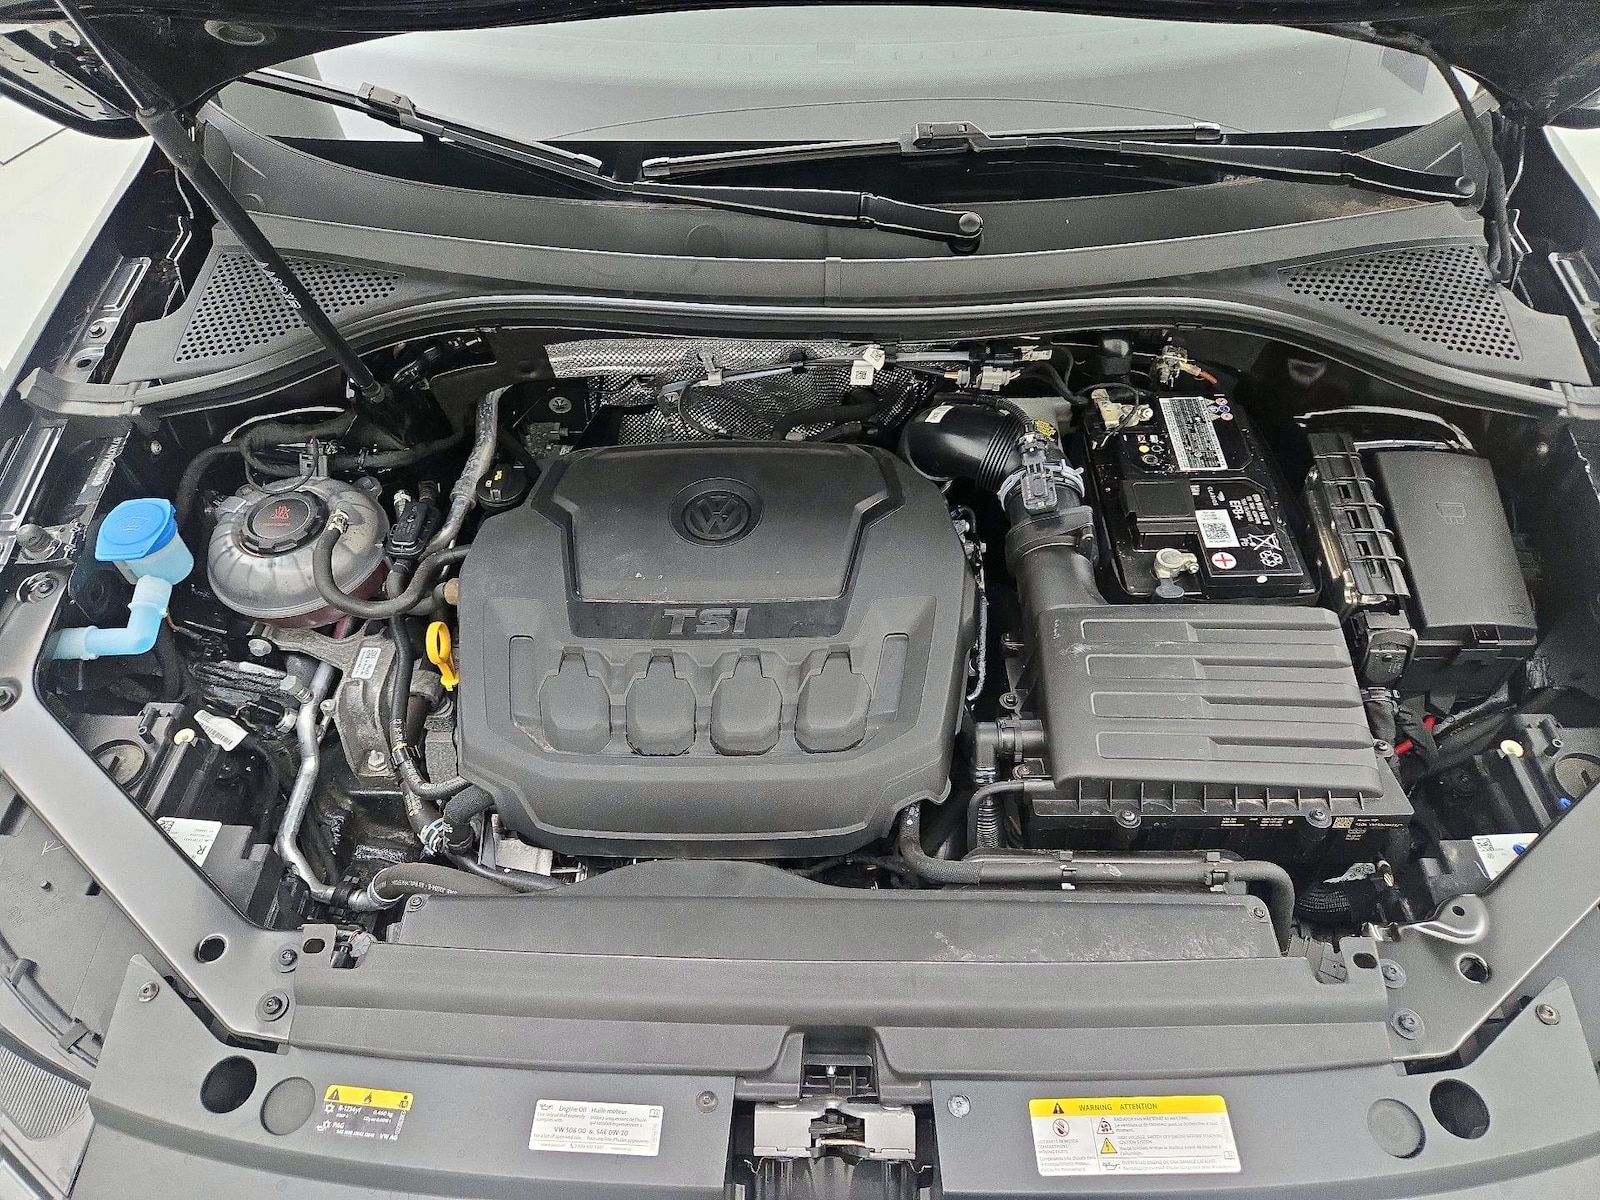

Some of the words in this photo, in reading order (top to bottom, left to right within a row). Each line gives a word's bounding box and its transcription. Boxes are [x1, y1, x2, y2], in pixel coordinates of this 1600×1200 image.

[1229, 500, 1244, 520] EFB+
[663, 608, 750, 634] TSI
[558, 1105, 578, 1114] Engine
[1120, 1103, 1158, 1111] ATTENTION
